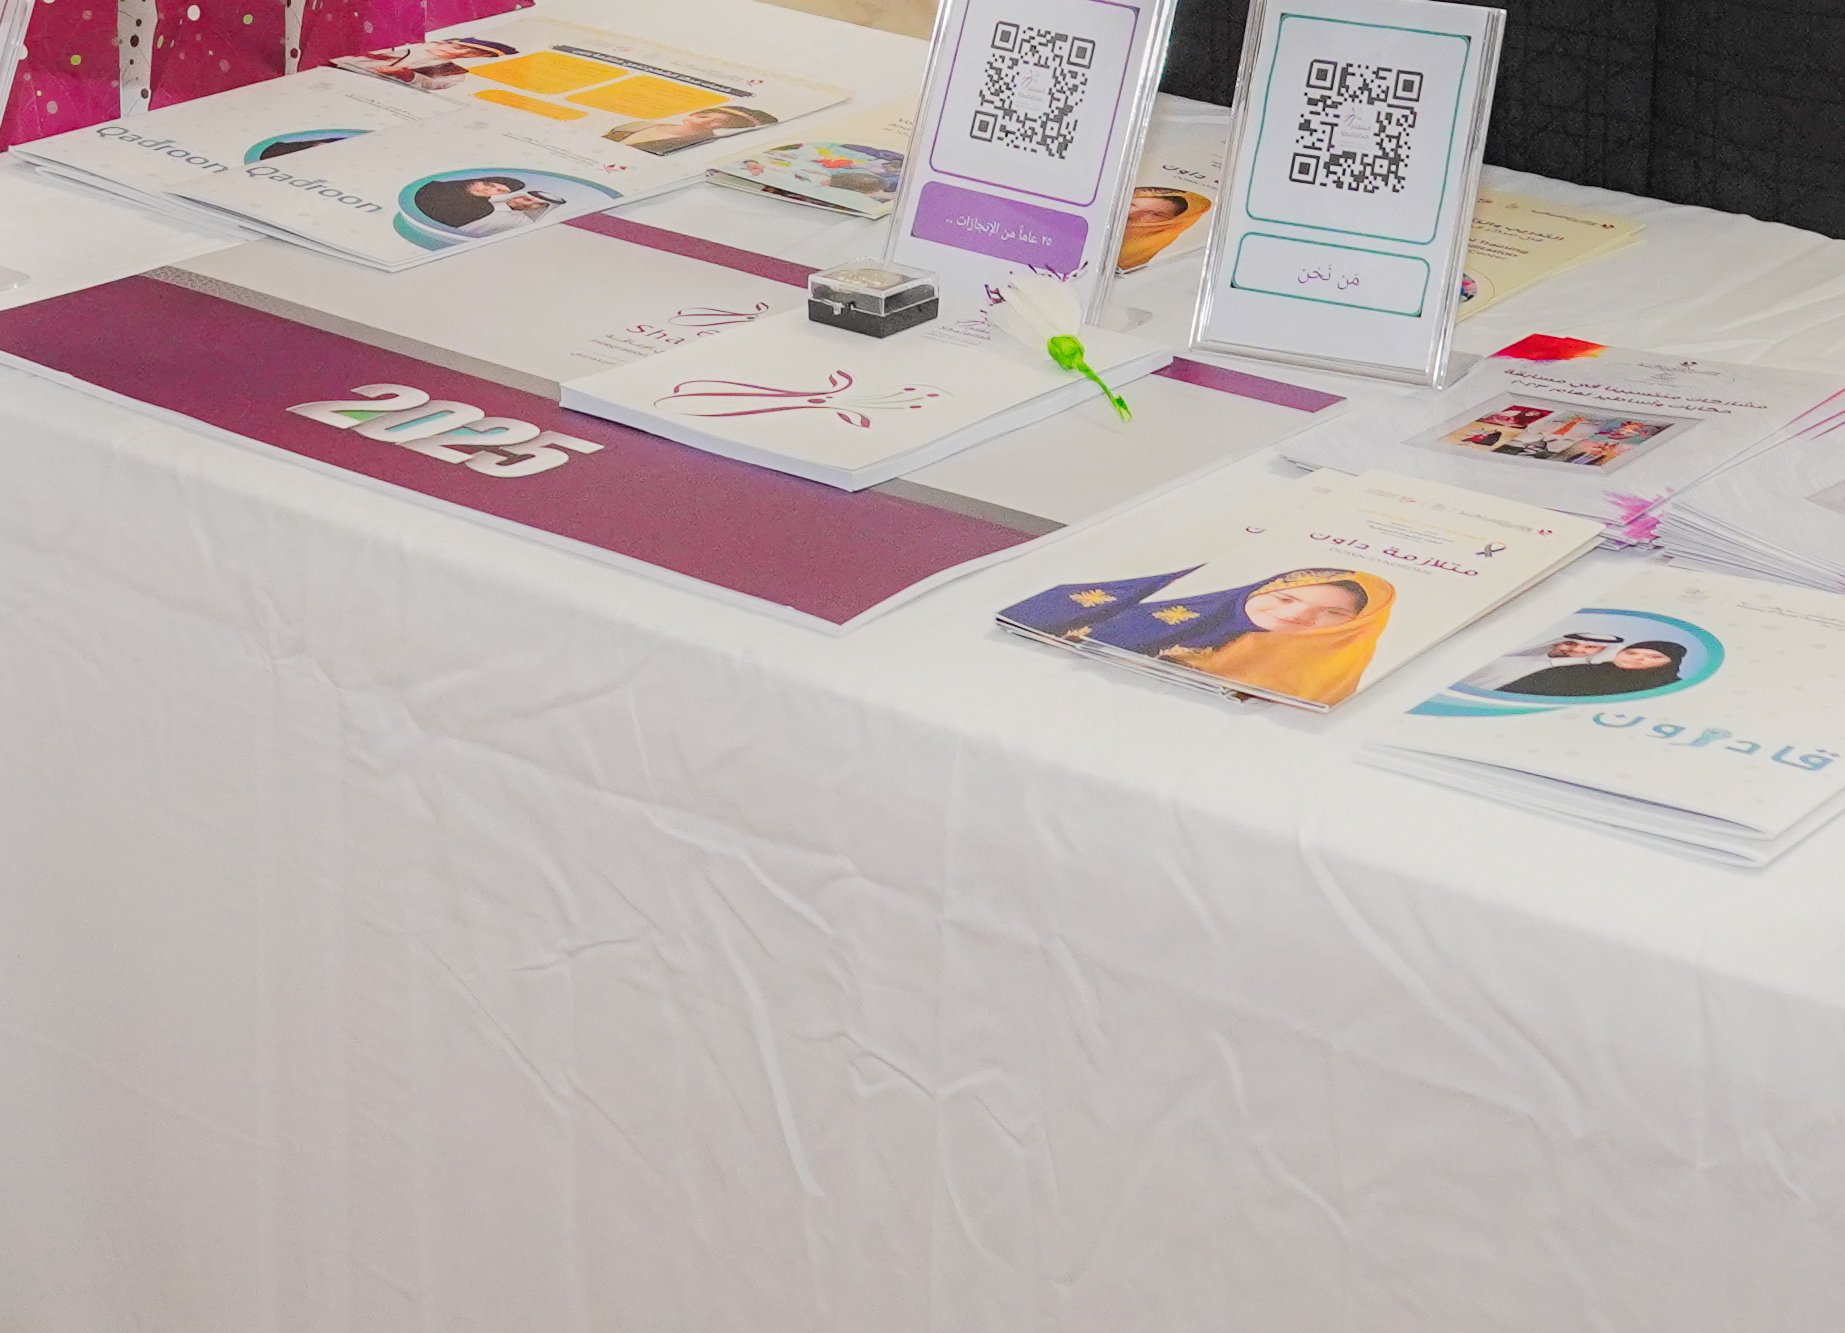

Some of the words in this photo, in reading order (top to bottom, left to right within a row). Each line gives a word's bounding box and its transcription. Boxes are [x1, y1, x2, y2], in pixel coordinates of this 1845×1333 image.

[96, 125, 229, 175] Qadroon
[246, 165, 383, 213] Qadroon
[1000, 229, 1016, 241] من
[1041, 235, 1052, 247] ٢٥
[286, 383, 605, 478] 2025
[1309, 531, 1370, 550] داون
[1382, 545, 1479, 577] متلازمة
[1592, 712, 1841, 772] قادرون
